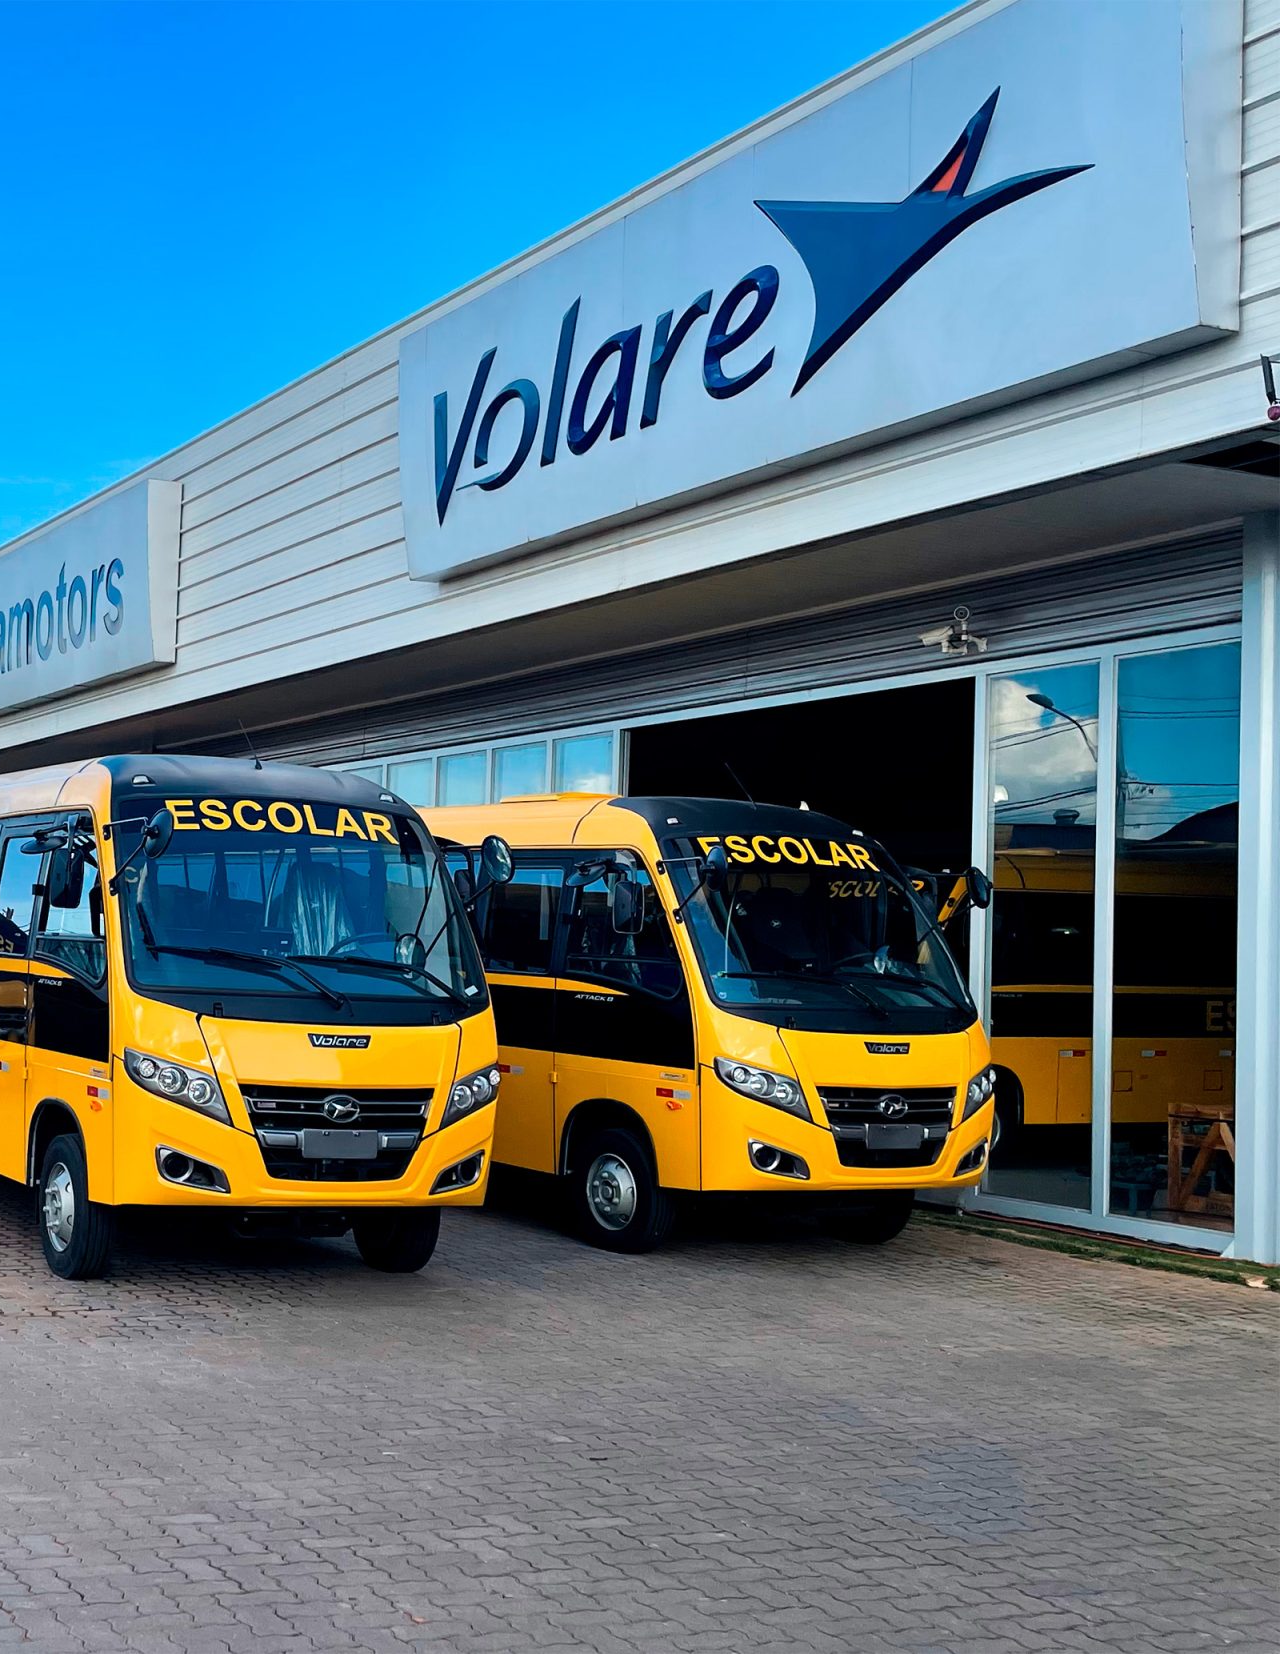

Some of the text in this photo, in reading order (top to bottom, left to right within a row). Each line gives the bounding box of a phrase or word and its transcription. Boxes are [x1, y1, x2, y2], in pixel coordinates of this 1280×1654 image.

[433, 265, 780, 528] Volare
[165, 799, 399, 845] ESCOLAR
[697, 835, 880, 872] ESCOLAR
[575, 993, 606, 1001] ATTACK
[312, 1035, 367, 1047] Volare
[867, 1042, 909, 1053] Volare
